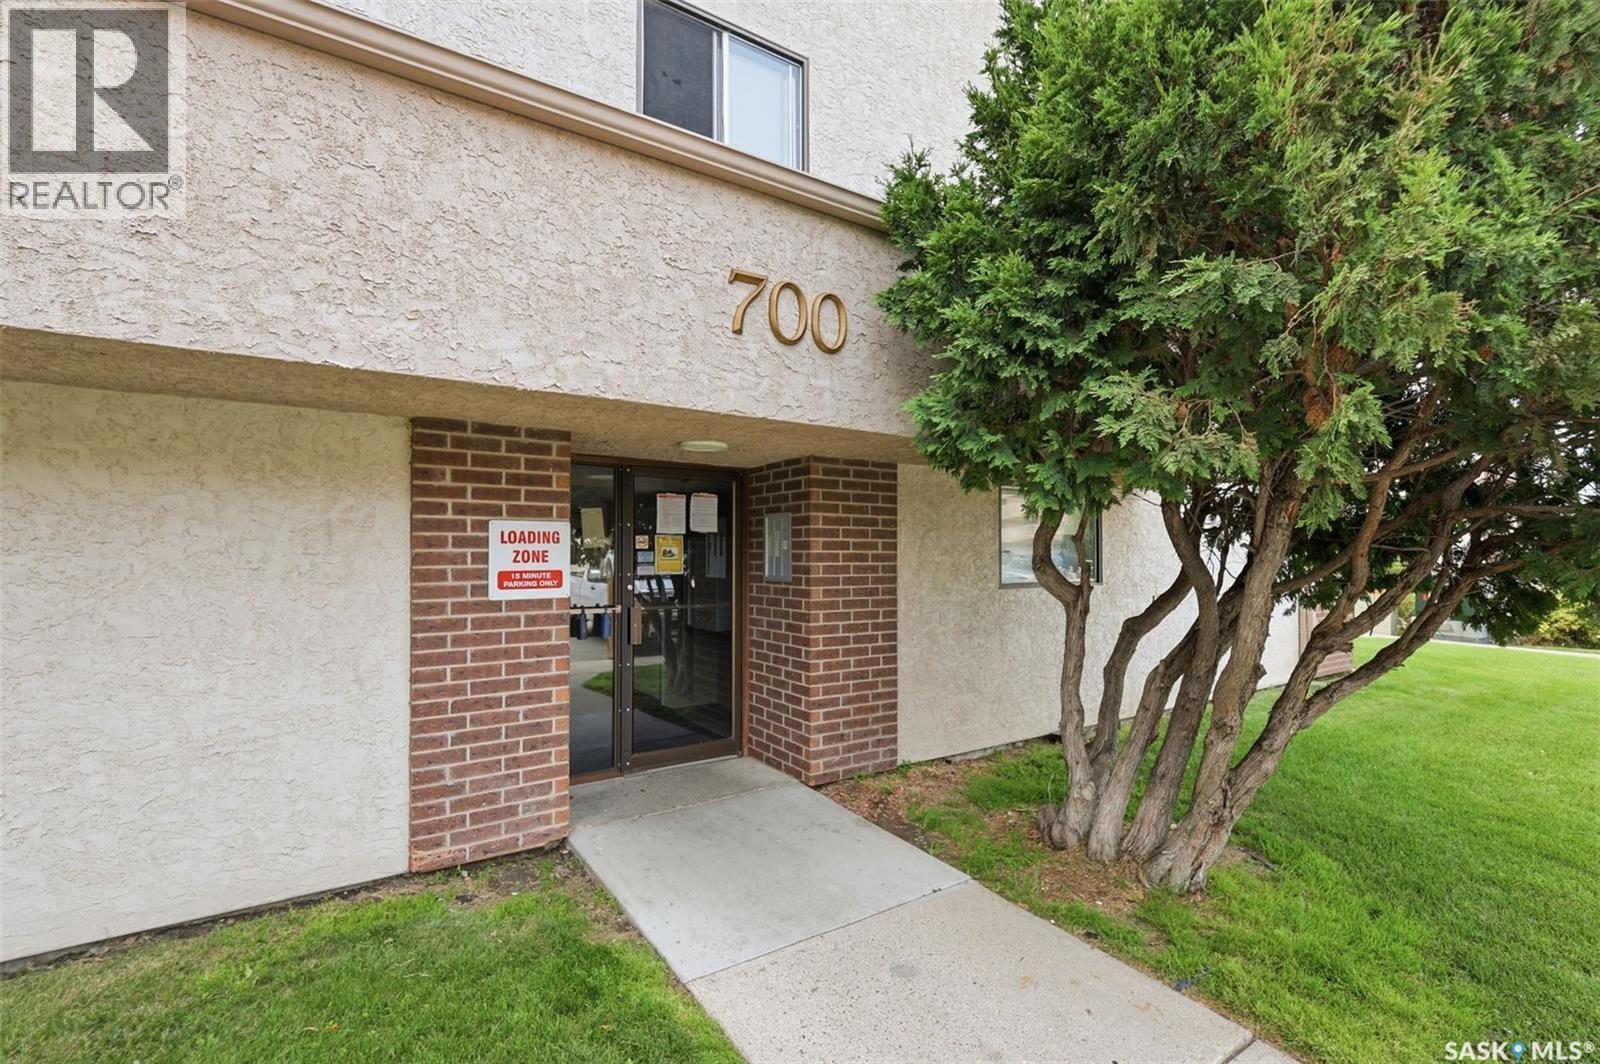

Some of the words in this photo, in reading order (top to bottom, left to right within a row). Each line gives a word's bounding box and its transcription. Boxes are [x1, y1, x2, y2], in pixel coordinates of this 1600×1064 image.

[728, 267, 848, 355] 700
[500, 530, 561, 545] LOADING
[512, 549, 549, 563] ZONE
[511, 572, 521, 580] 15
[503, 580, 538, 588] PARKING
[539, 579, 559, 587] ONLY
